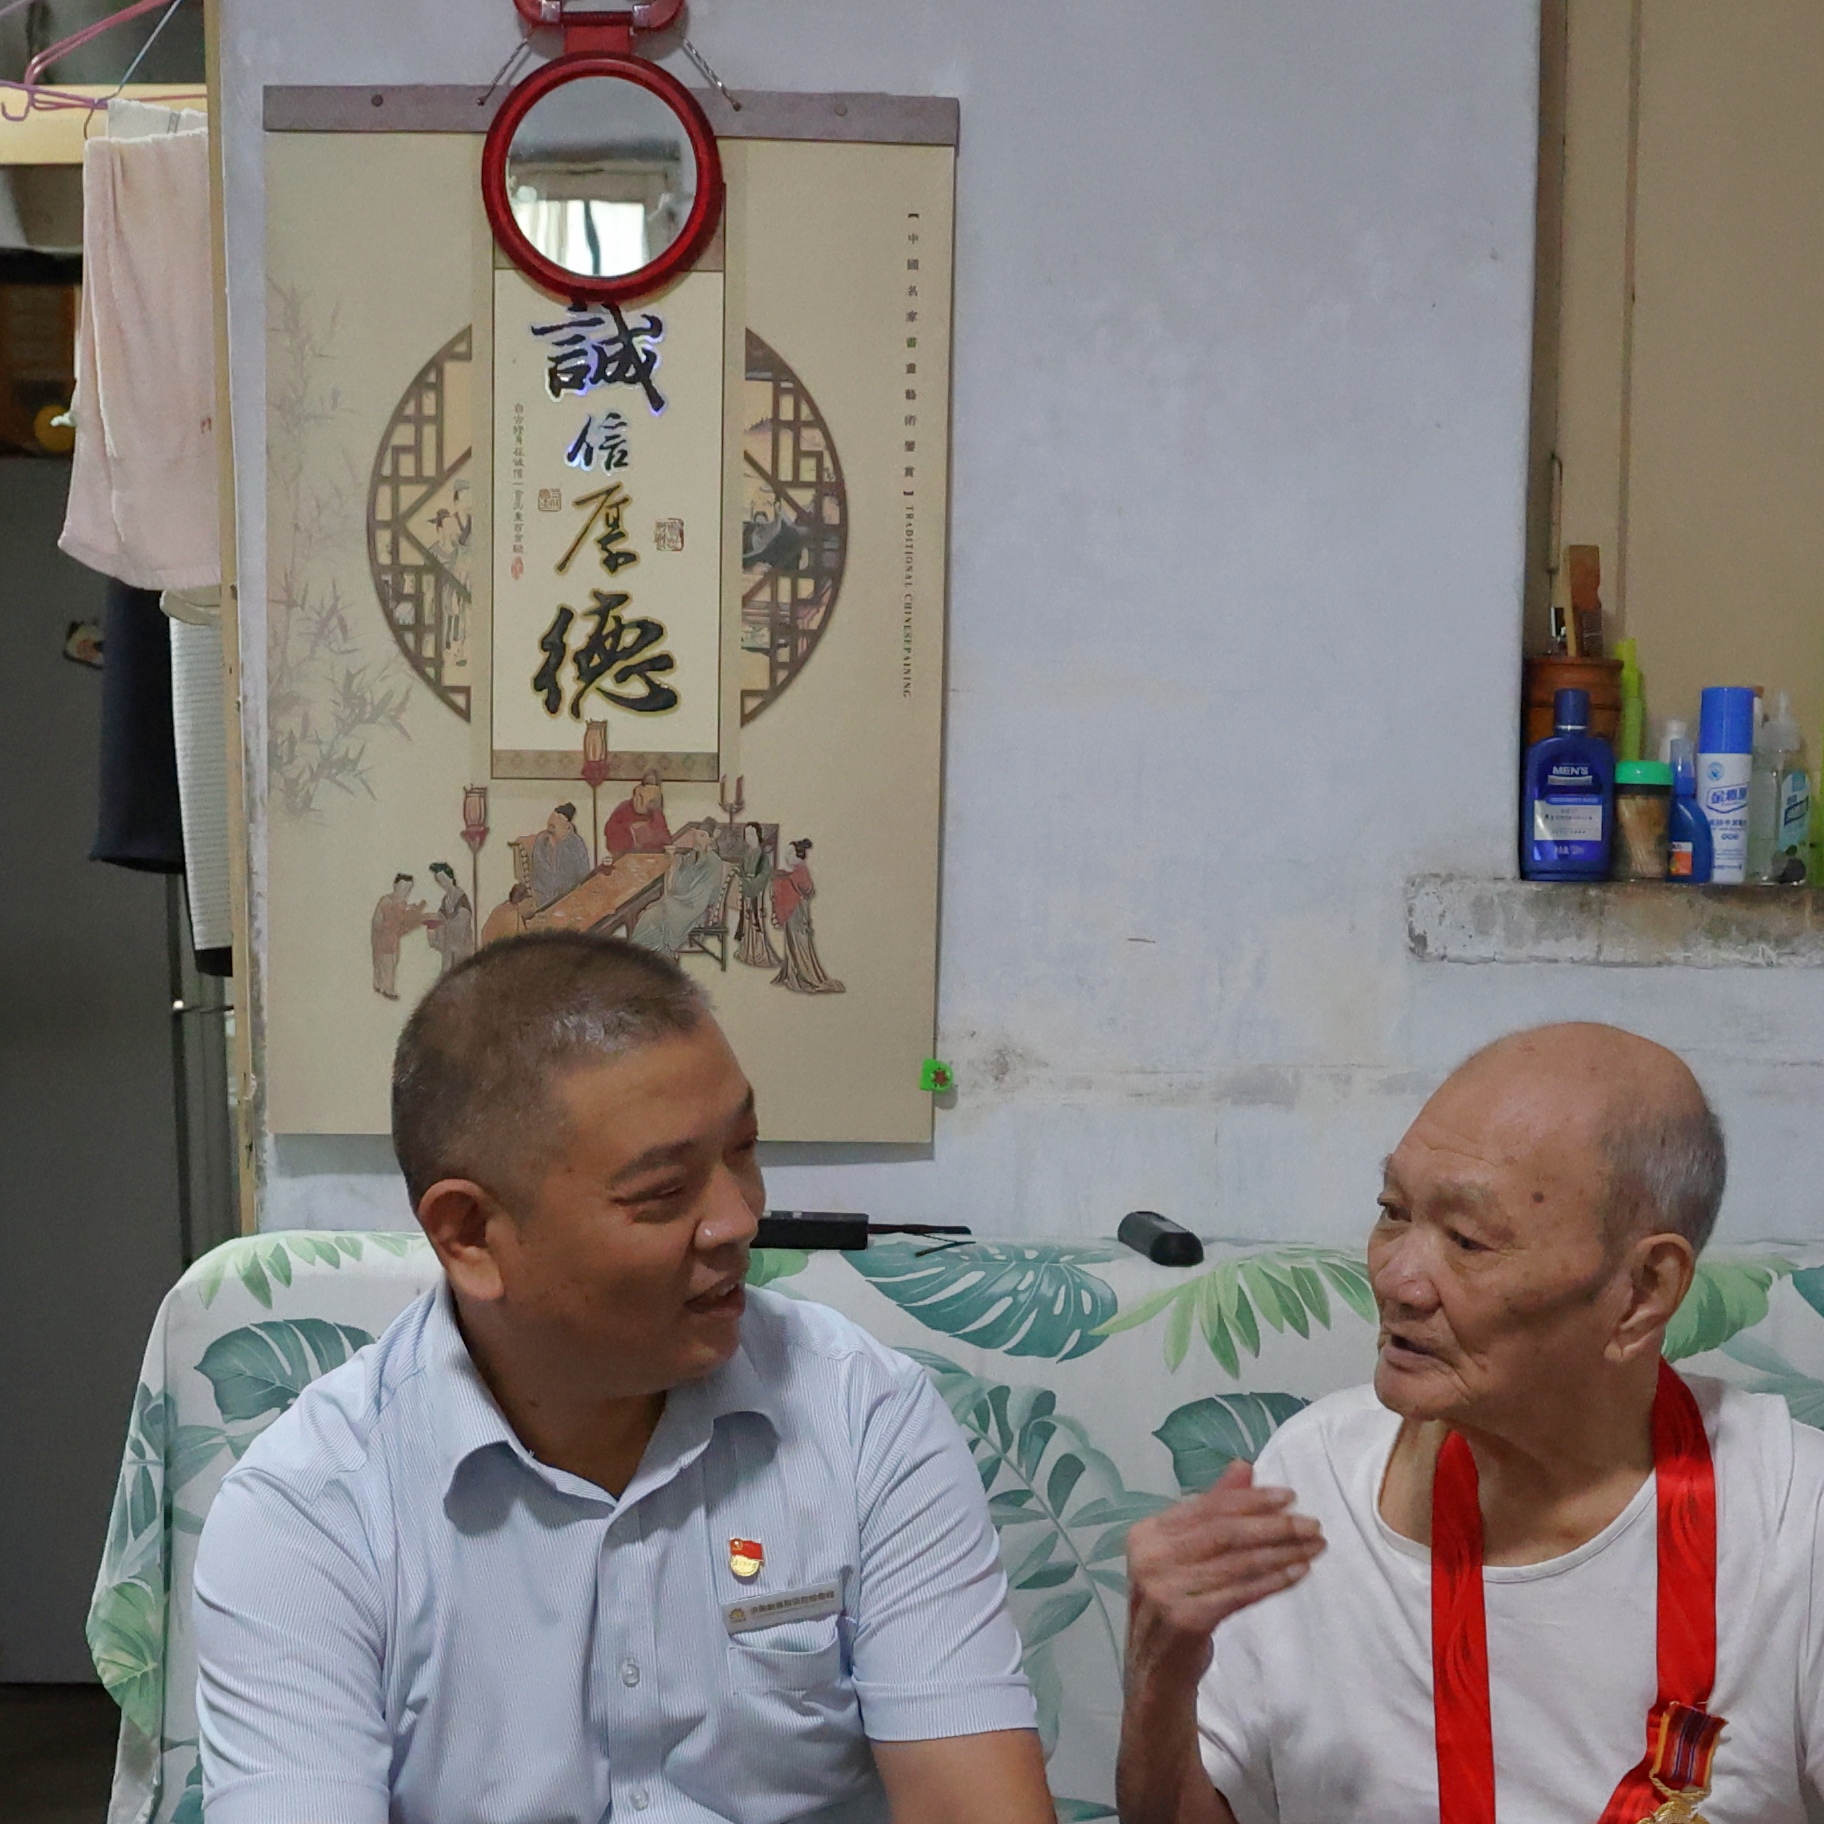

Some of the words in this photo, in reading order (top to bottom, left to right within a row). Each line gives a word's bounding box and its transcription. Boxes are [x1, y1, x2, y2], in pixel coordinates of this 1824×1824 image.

[532, 300, 679, 719] 誠信厚德
[904, 505, 915, 588] TRADITIONAL
[1552, 765, 1589, 776] MEN'S
